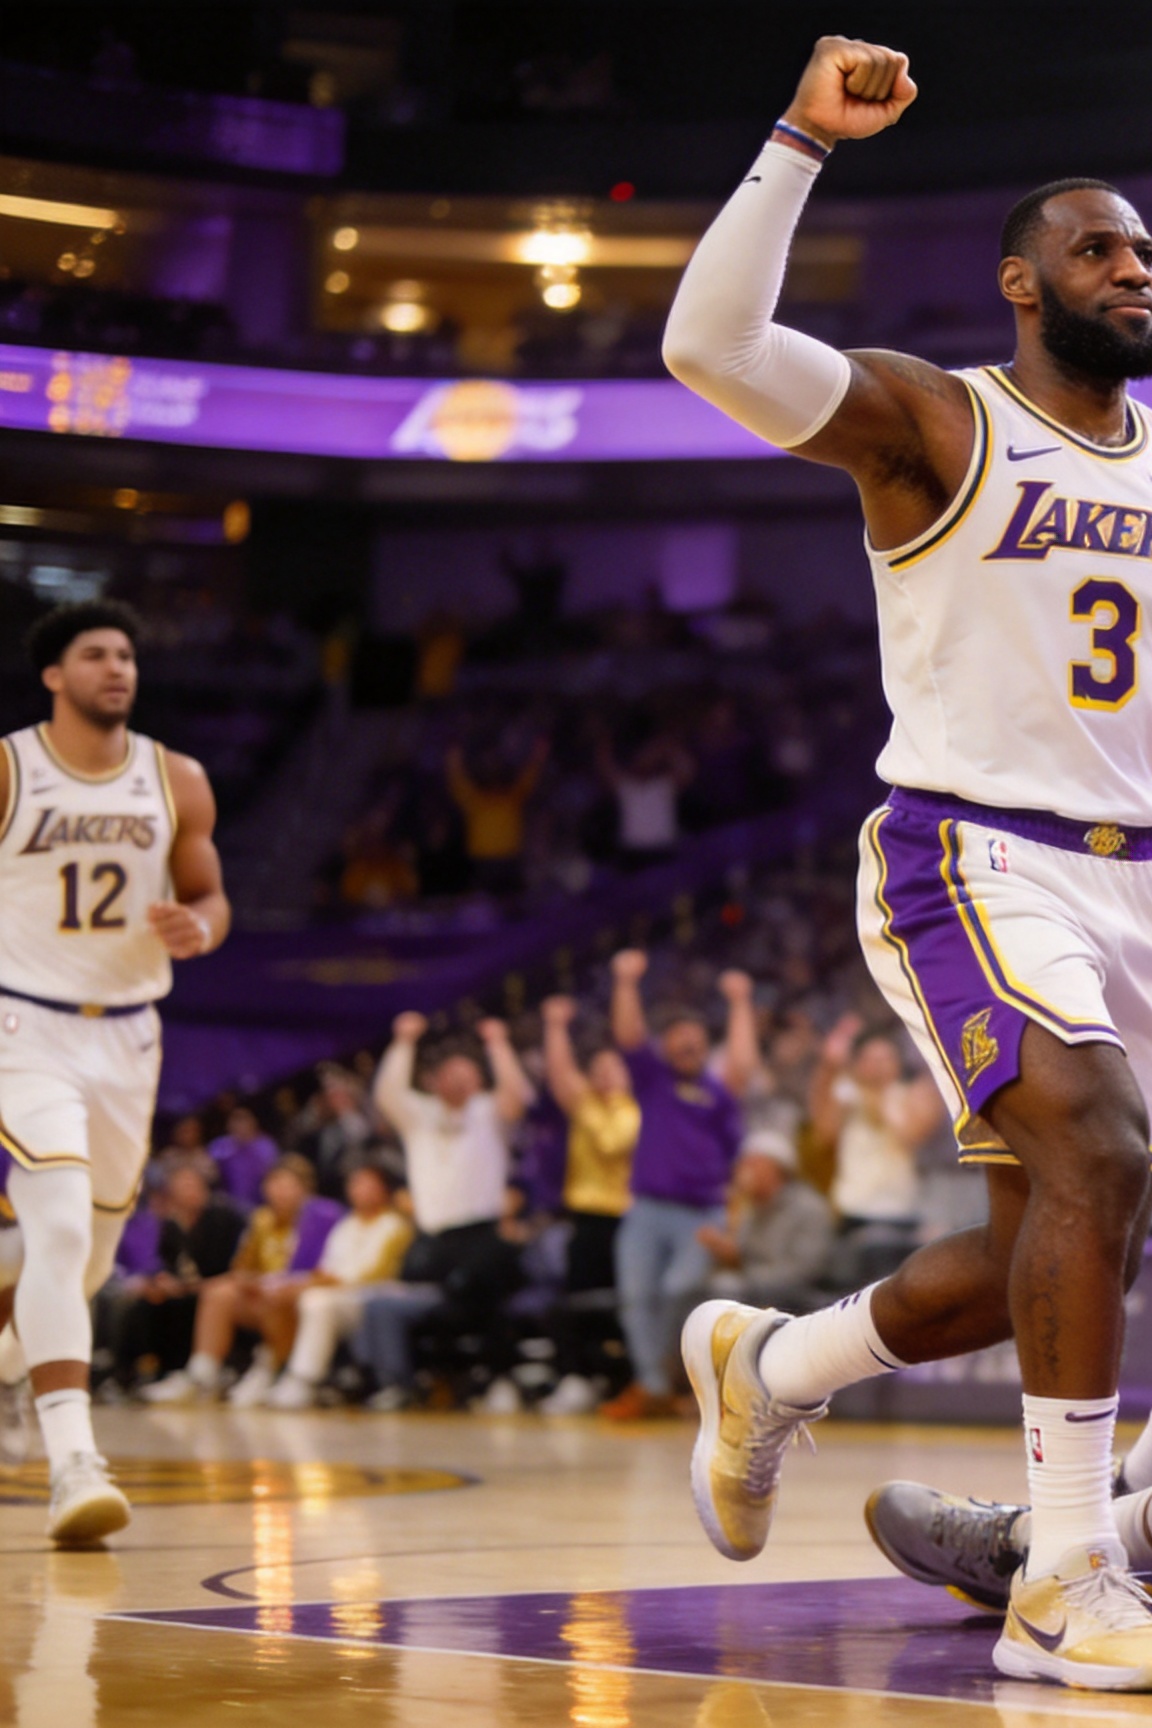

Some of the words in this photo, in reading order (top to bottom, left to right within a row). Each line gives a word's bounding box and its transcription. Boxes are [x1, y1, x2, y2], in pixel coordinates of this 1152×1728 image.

[1069, 576, 1141, 712] 3
[18, 807, 157, 856] LAKERS
[59, 861, 127, 932] 12
